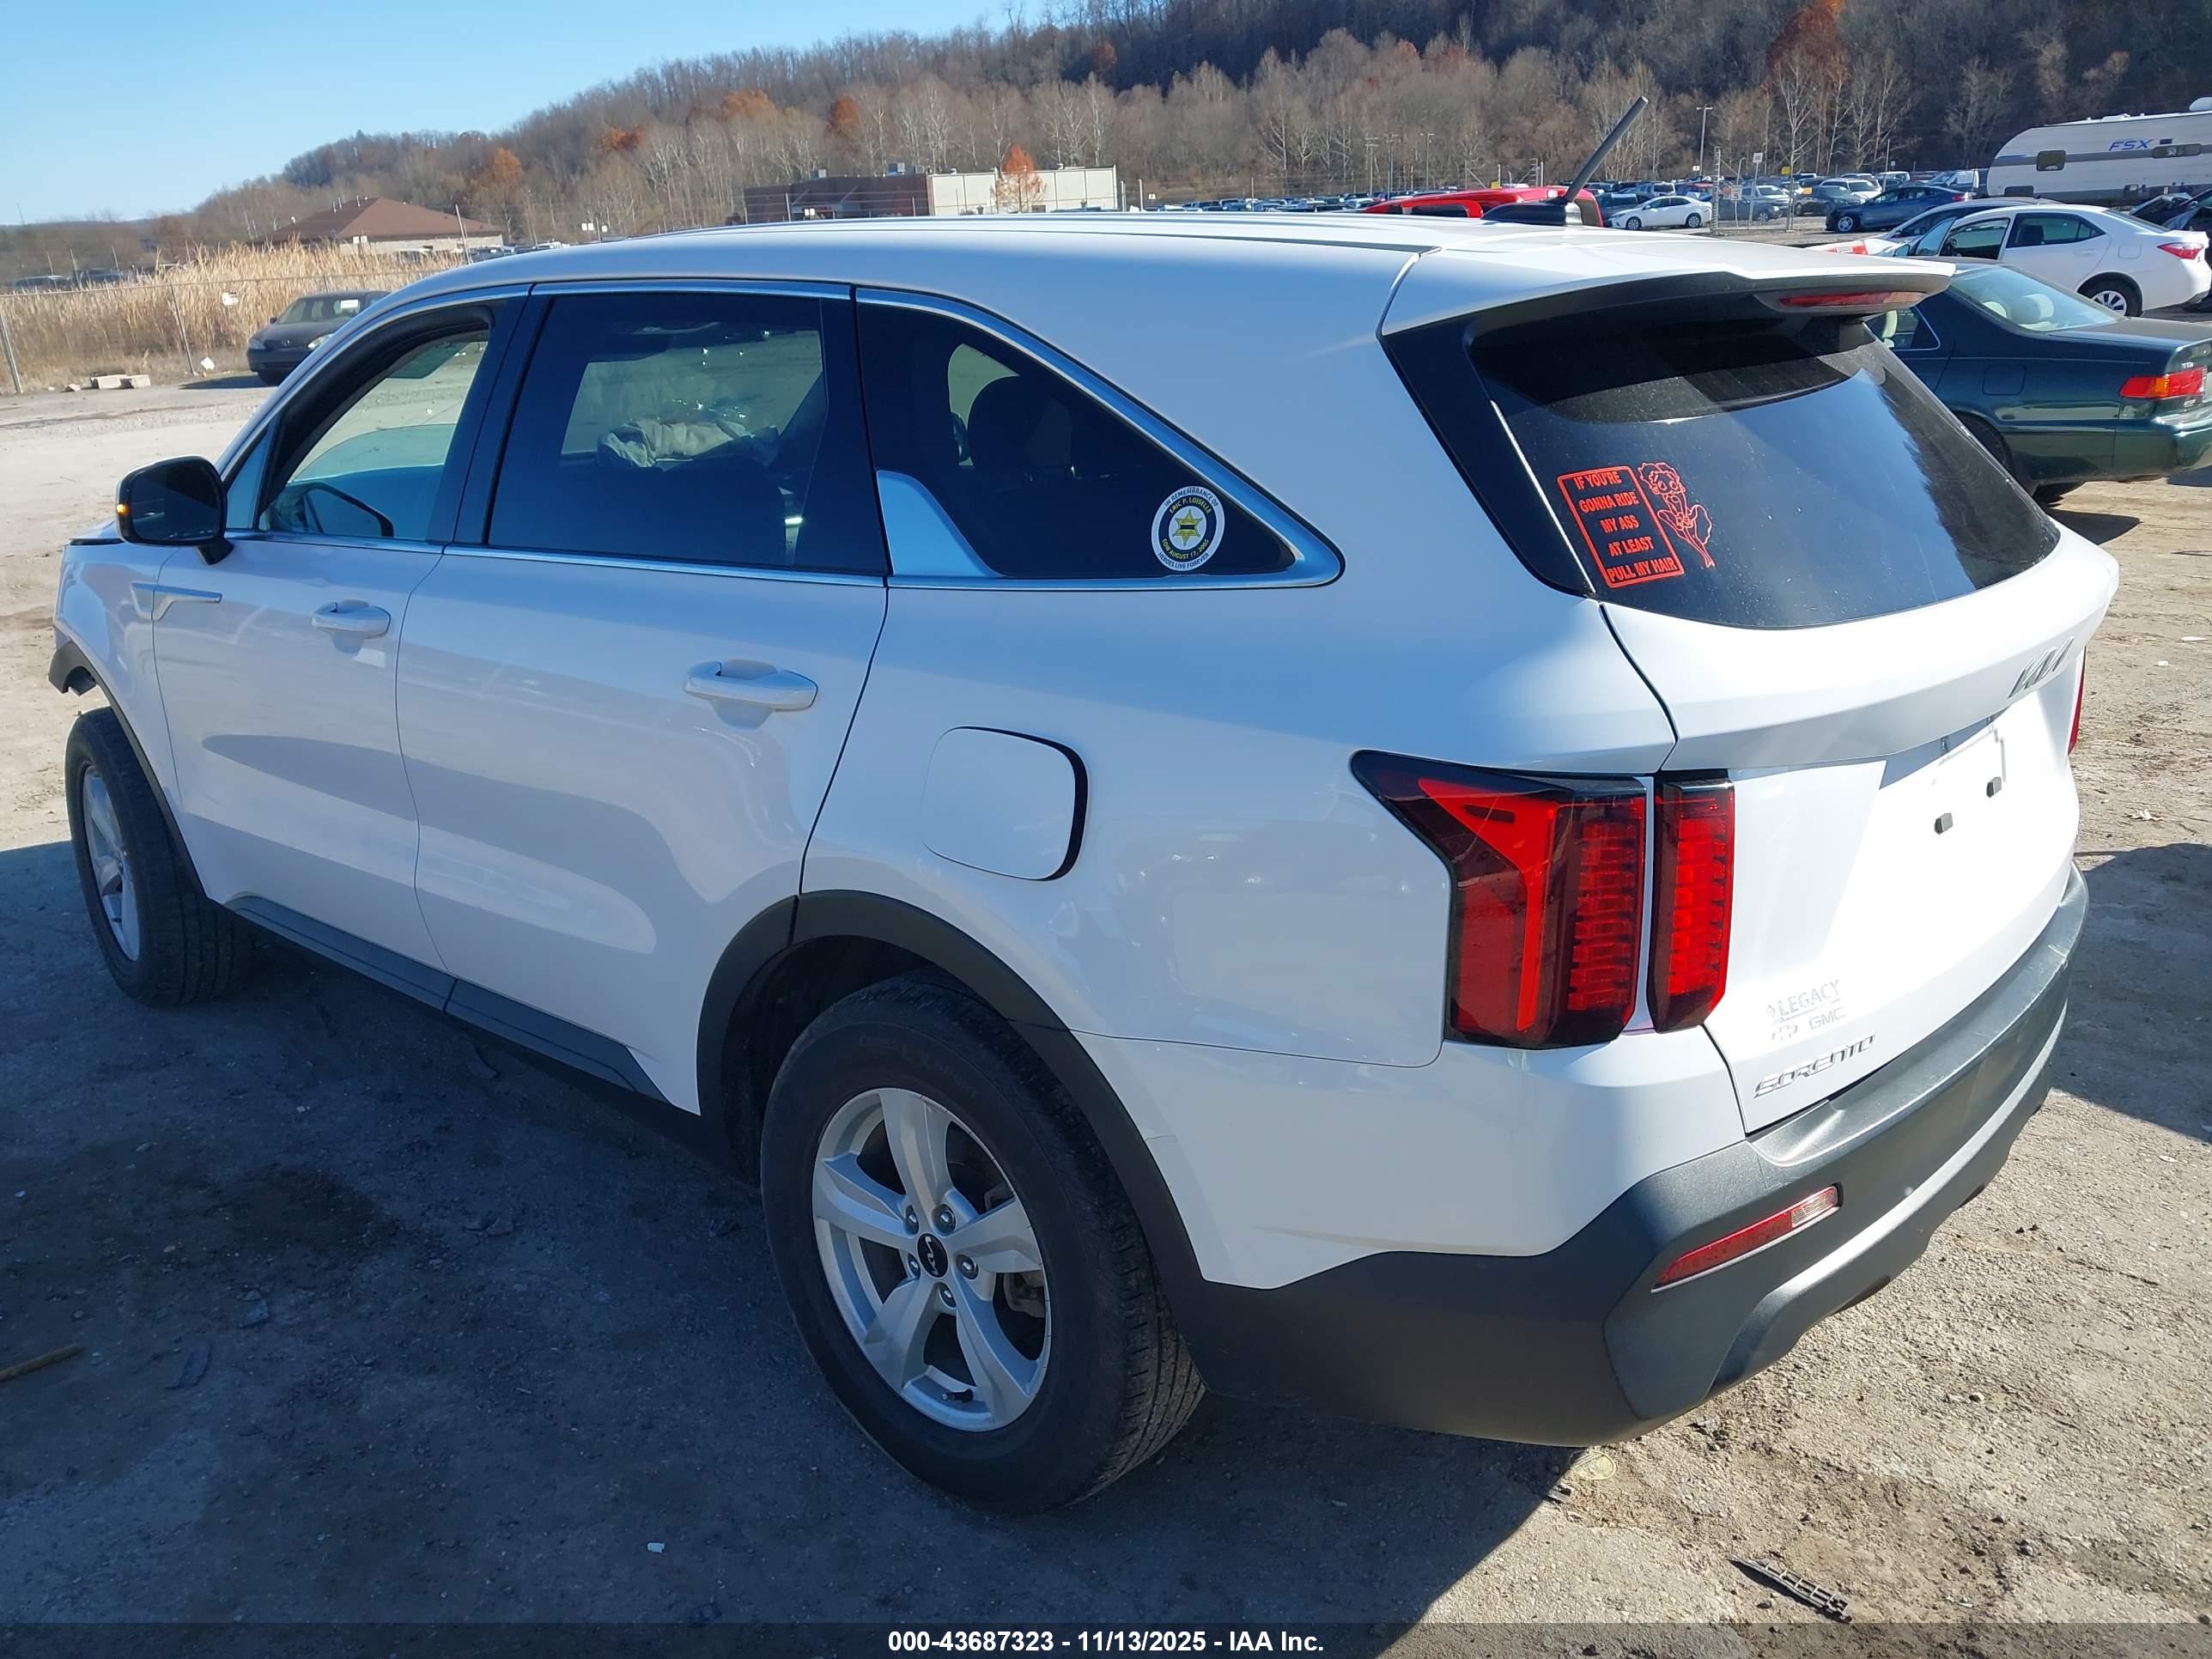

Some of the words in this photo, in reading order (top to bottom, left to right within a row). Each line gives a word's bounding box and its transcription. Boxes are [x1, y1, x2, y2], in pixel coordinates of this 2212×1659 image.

[2109, 138, 2154, 151] FSX
[1574, 477, 1585, 490] IF
[1585, 471, 1622, 487] YOU'RE
[1170, 487, 1213, 502] REMEMBRANCE
[1578, 495, 1616, 513] GONNA
[1615, 491, 1639, 506] RIDE
[1169, 501, 1182, 514] ERIC
[1600, 517, 1617, 533] MY
[1620, 515, 1639, 531] ASS
[1169, 550, 1188, 560] AUGUST
[1607, 541, 1622, 556] AT
[1622, 537, 1653, 554] LEAST
[1187, 552, 1209, 568] FOREVER
[1607, 566, 1635, 581] PULL
[1636, 560, 1652, 576] MY
[1651, 557, 1677, 572] HAIR
[1778, 979, 1839, 1016] LEGACY
[1809, 1006, 1845, 1030] GMC
[1753, 1034, 1875, 1098] SORENTO
